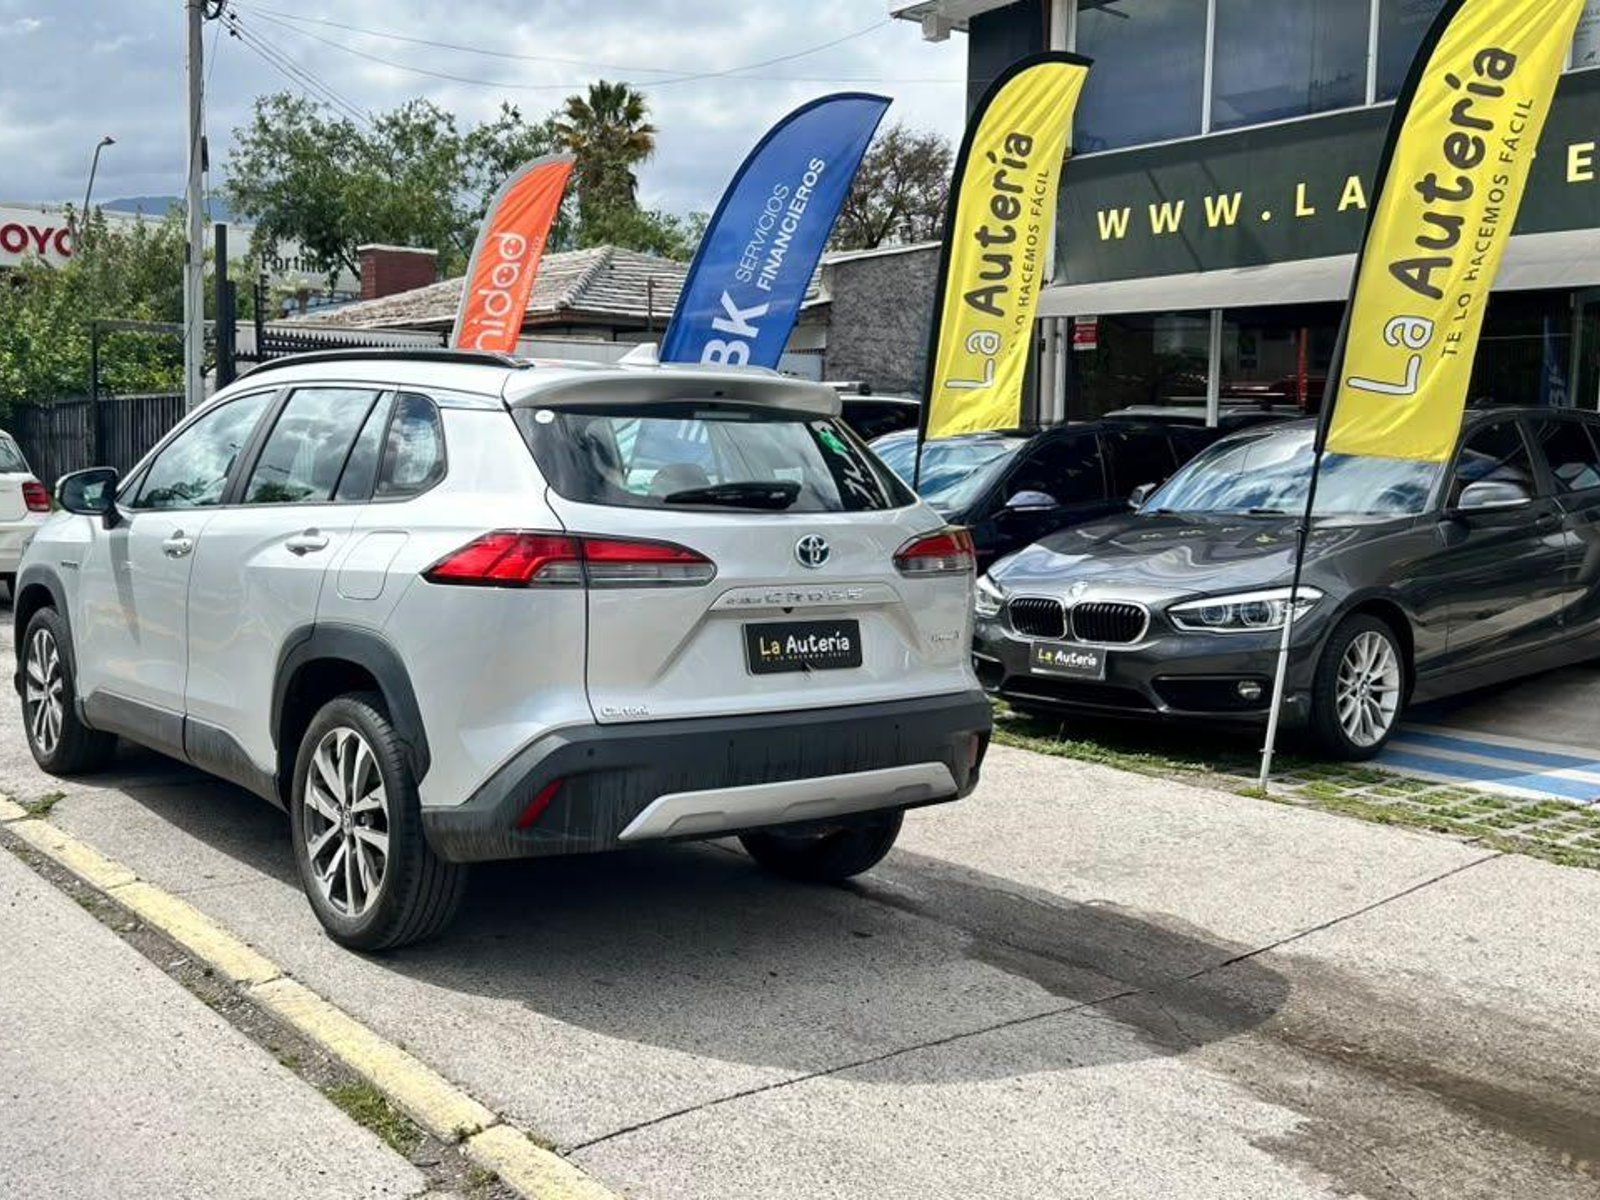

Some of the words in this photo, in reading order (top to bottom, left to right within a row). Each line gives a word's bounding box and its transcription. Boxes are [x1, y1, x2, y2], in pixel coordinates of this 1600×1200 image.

[756, 157, 826, 292] FINANCIEROS
[963, 132, 1034, 318] Autería
[1388, 46, 1518, 301] Autería
[1441, 331, 1462, 358] TE
[1453, 293, 1472, 322] LO
[1464, 174, 1509, 282] HACEMOS
[1499, 98, 1534, 163] FÁCIL
[735, 183, 790, 283] SERVICIOS
[1018, 224, 1041, 307] HACEMOS
[1031, 169, 1050, 217] FÁCIL
[945, 329, 1002, 389] La
[1345, 314, 1435, 396] La
[759, 636, 781, 656] La
[786, 630, 850, 654] Autería
[1038, 647, 1053, 661] La
